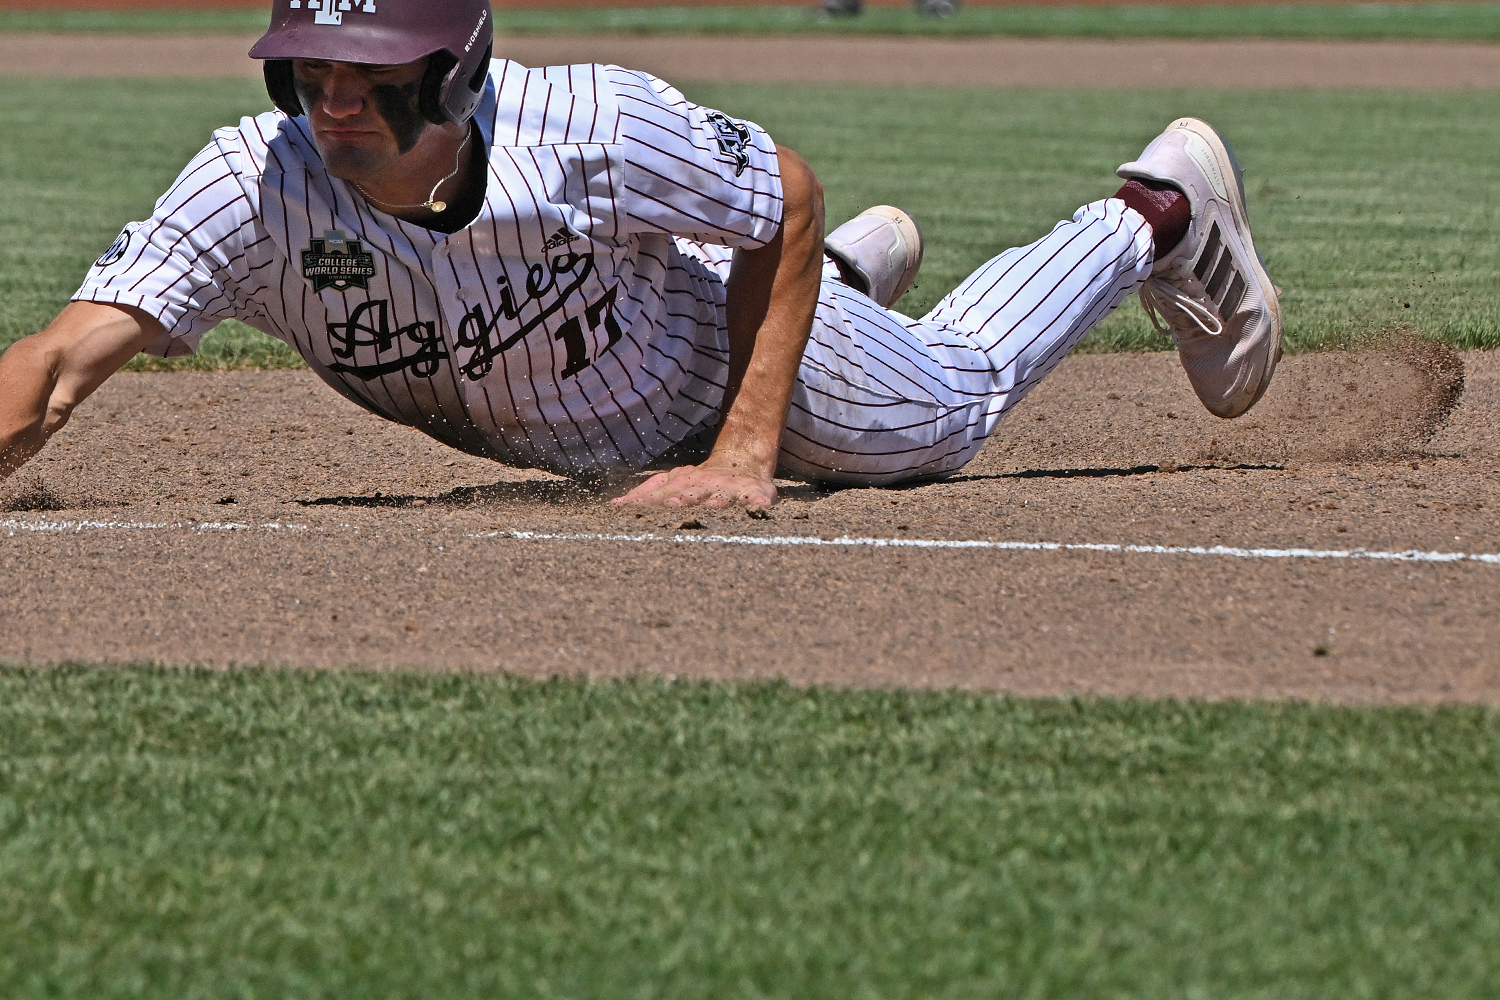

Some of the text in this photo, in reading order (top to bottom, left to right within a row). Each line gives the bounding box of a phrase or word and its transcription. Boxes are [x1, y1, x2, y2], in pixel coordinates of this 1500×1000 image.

[464, 9, 488, 53] EVOSHIELD
[305, 266, 373, 277] WORLD SERIES
[318, 258, 358, 267] COLLEGE
[325, 252, 594, 382] Aggies
[554, 283, 622, 381] 17
